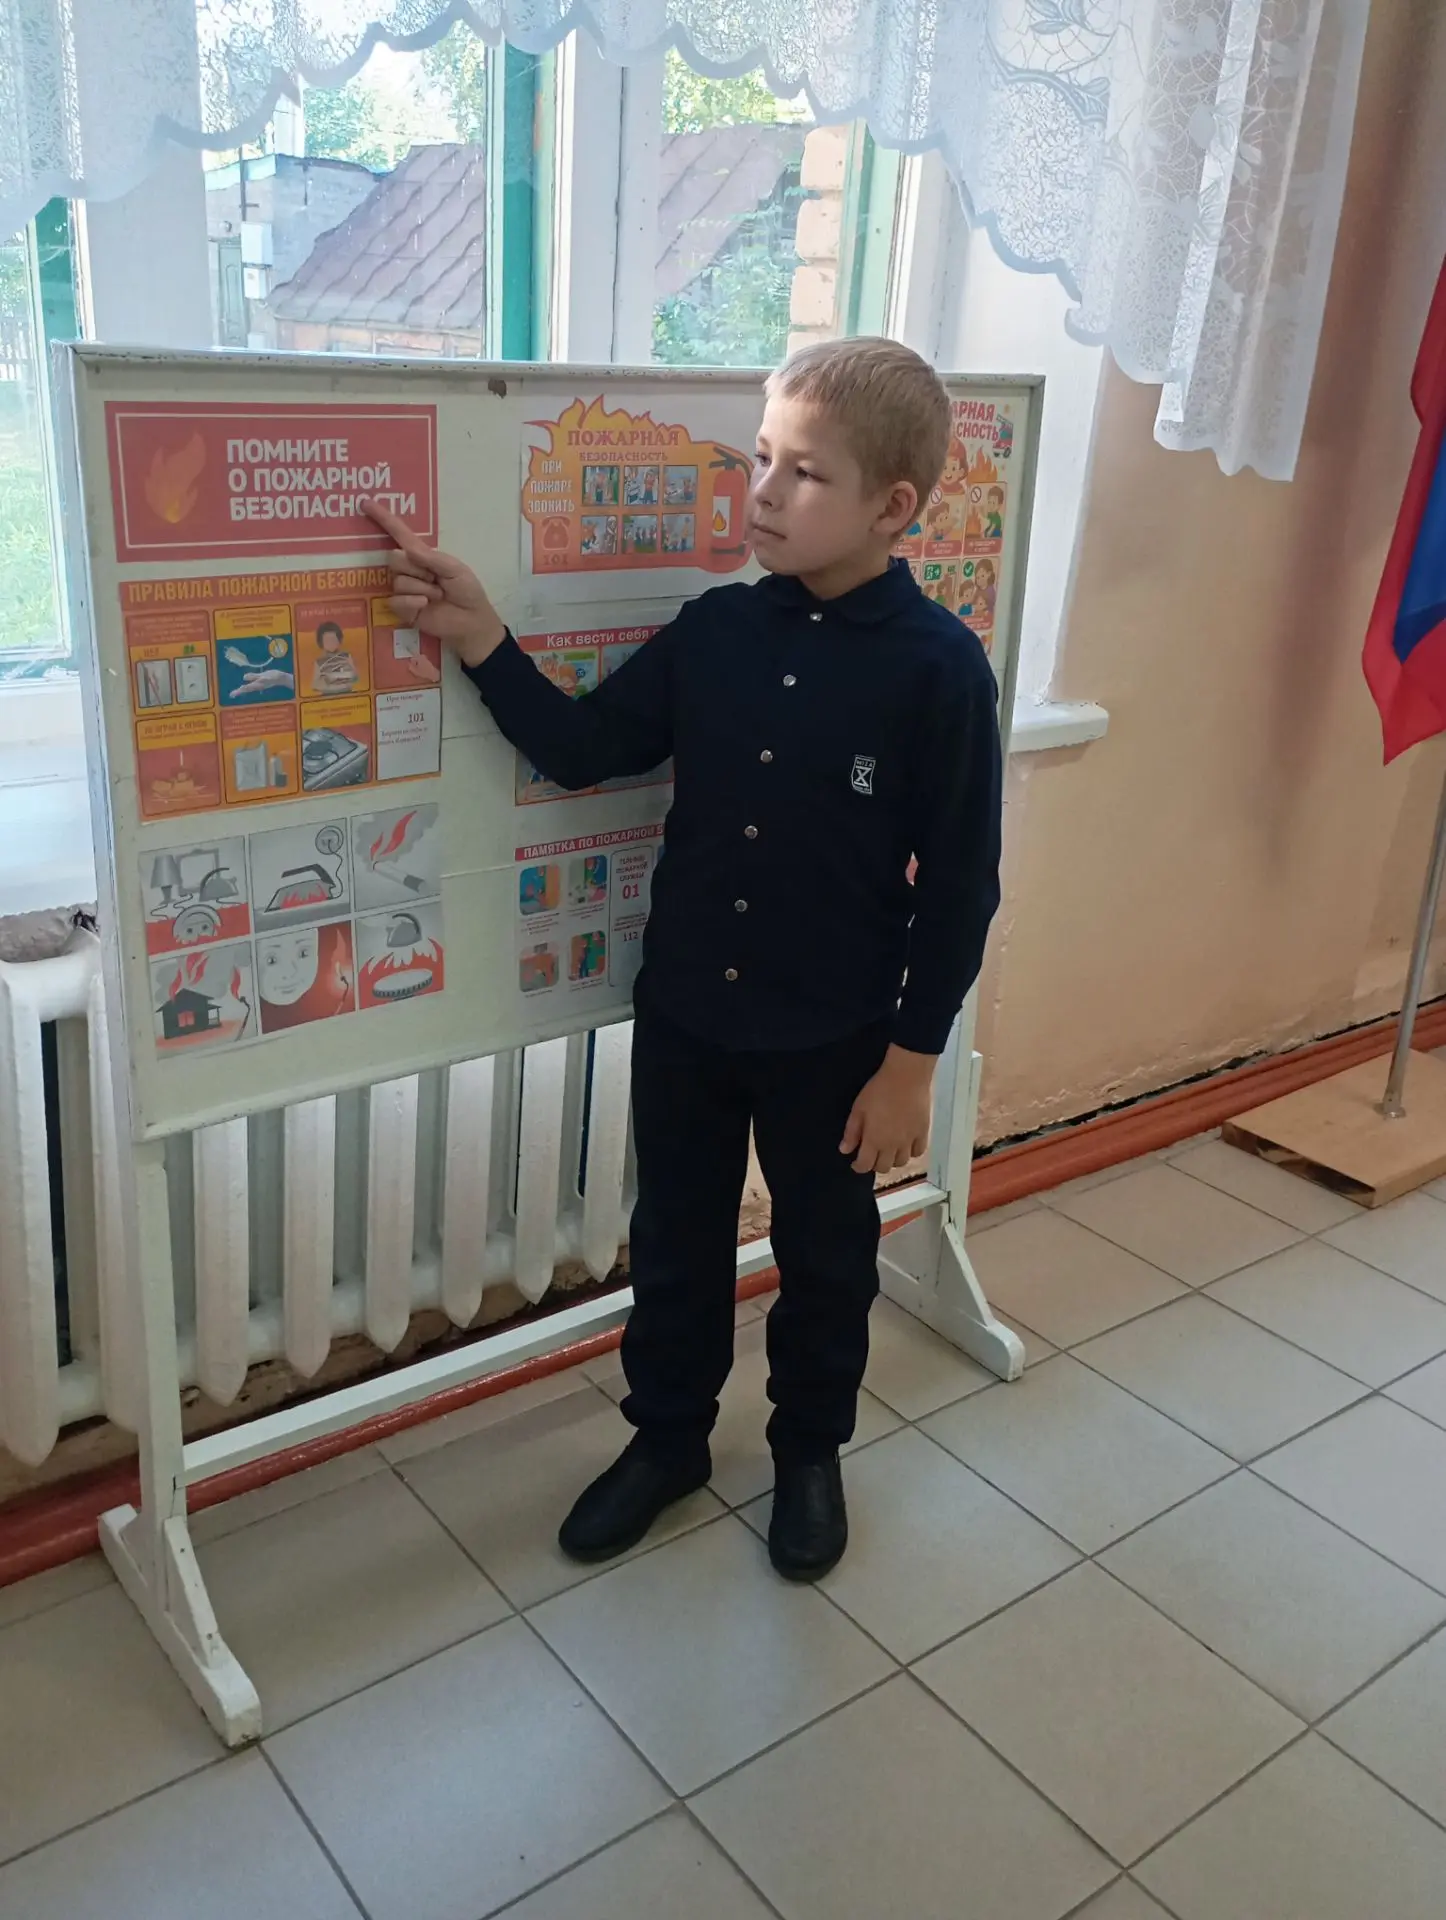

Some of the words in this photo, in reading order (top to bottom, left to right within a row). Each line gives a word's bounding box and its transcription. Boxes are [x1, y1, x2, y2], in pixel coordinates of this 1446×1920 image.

[567, 430, 680, 446] ПОЖАРНАЯ
[226, 439, 349, 463] ПОМНИТЕ
[579, 451, 668, 462] БЕЗОПАСНОСТЬ
[541, 460, 562, 475] ПРИ
[228, 468, 248, 492] О
[254, 461, 391, 491] ПОЖАРНОЙ
[530, 479, 572, 494] ПОЖАРЕ
[527, 498, 575, 514] ЗВОНИТЬ
[129, 580, 214, 603] ПРАВИЛА
[218, 572, 312, 598] ПОЖАРНОЙ
[547, 634, 572, 648] Как
[576, 631, 614, 645] вести
[618, 628, 649, 641] себя
[408, 712, 425, 724] 101
[523, 839, 576, 859] ПАМЯТКА
[578, 836, 594, 849] ПО
[622, 883, 640, 900] 01
[623, 931, 639, 942] 112
